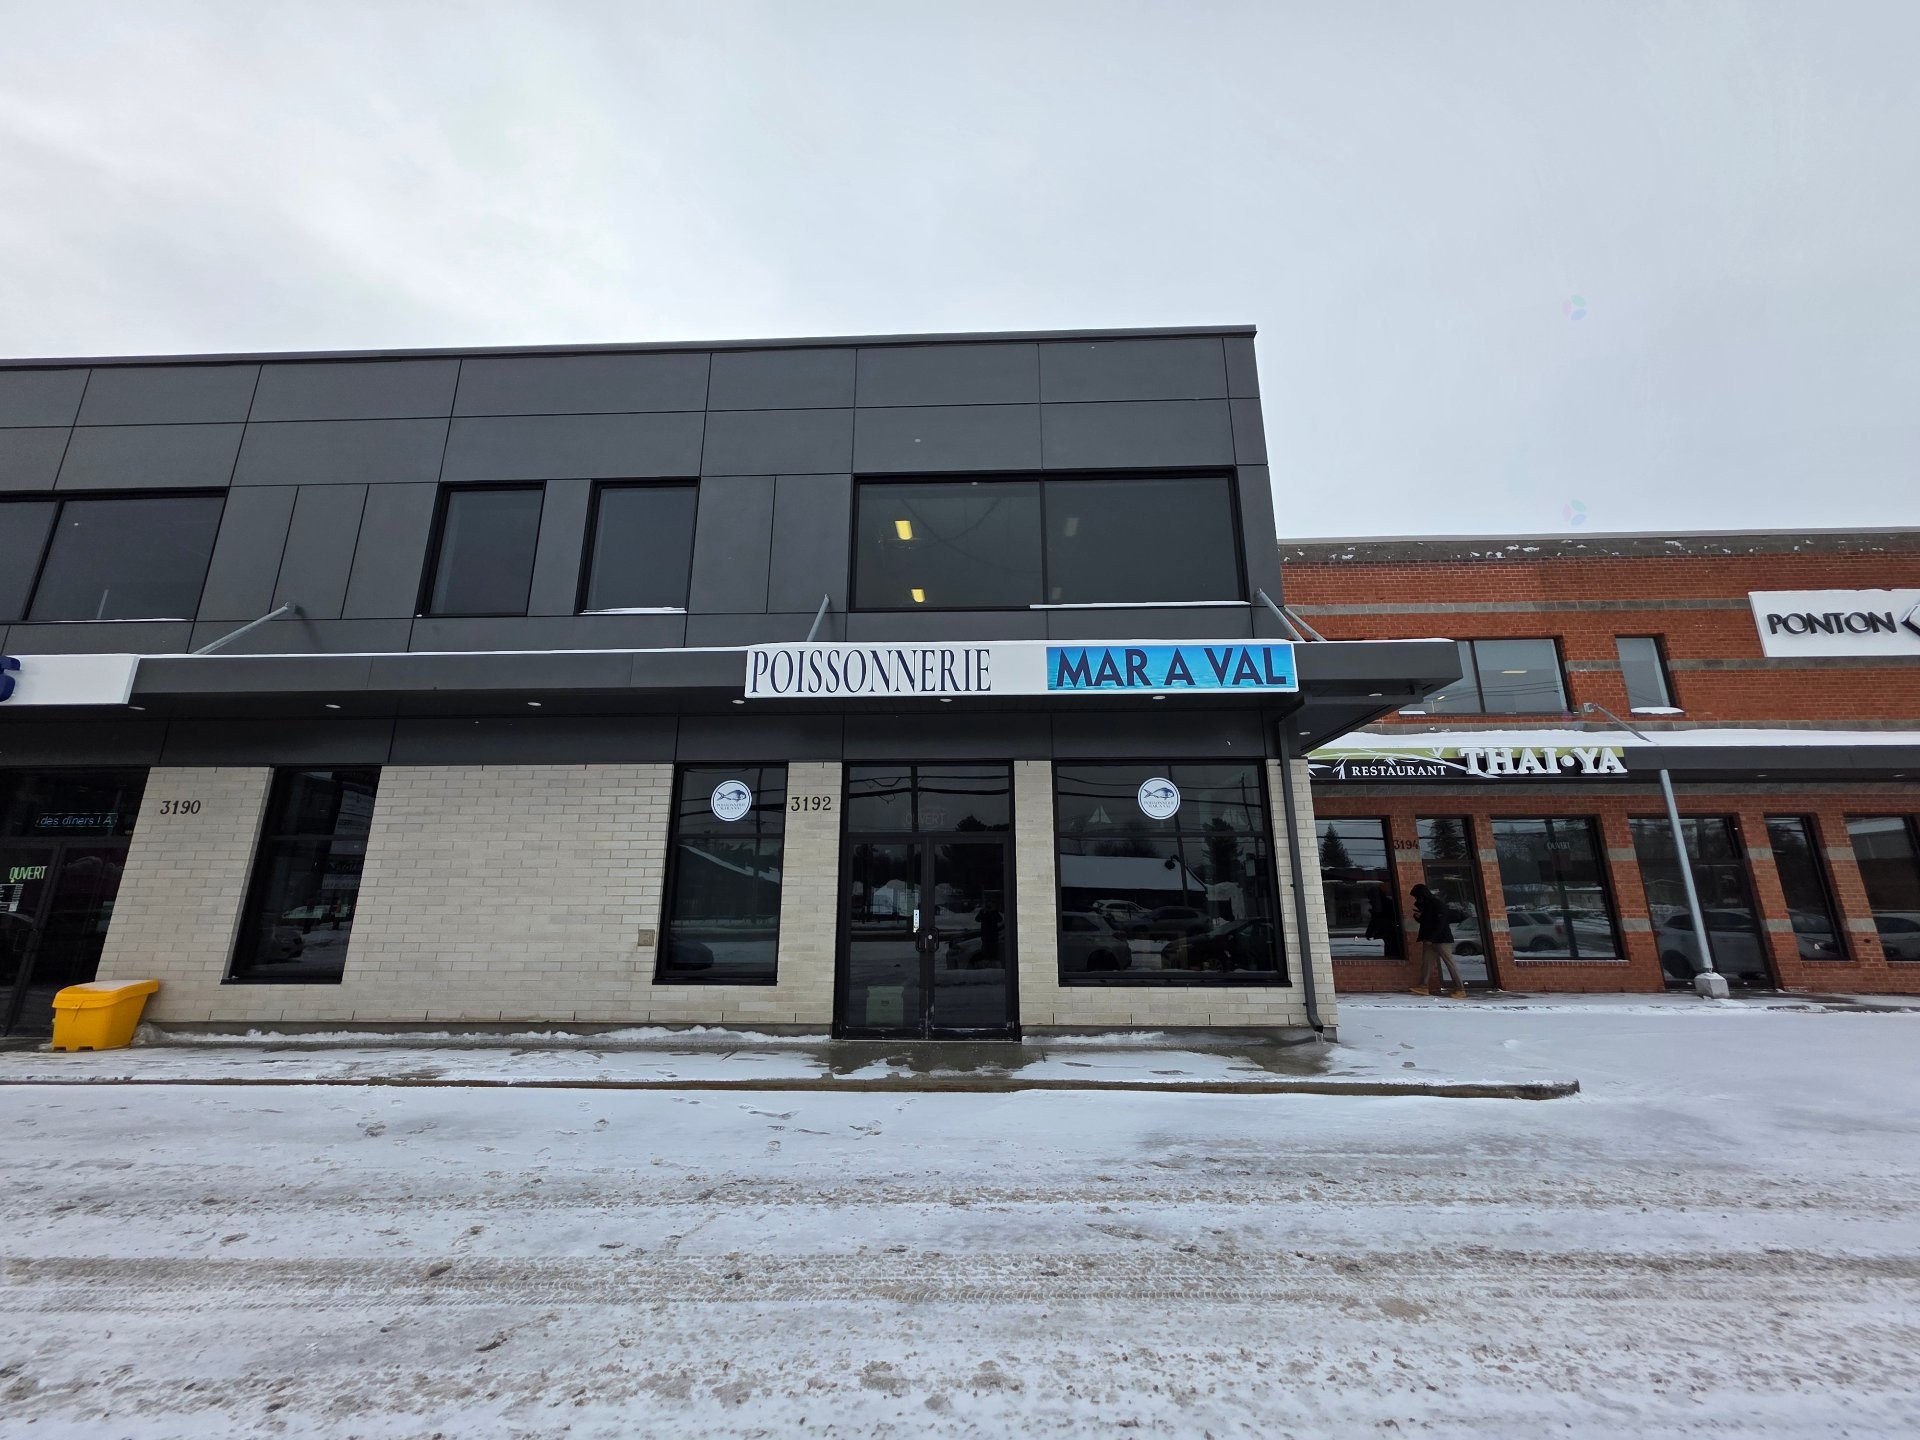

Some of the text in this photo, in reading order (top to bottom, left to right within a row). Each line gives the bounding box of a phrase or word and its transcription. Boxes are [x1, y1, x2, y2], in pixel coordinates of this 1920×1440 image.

[1766, 611, 1897, 635] PONTON
[750, 646, 1287, 694] POISSONNERIE MAR A VAL
[1351, 765, 1447, 776] RESTAURANT
[159, 799, 202, 815] 3190
[790, 796, 832, 812] 3192
[1393, 839, 1419, 850] 3194
[9, 865, 48, 880] OUVERT
